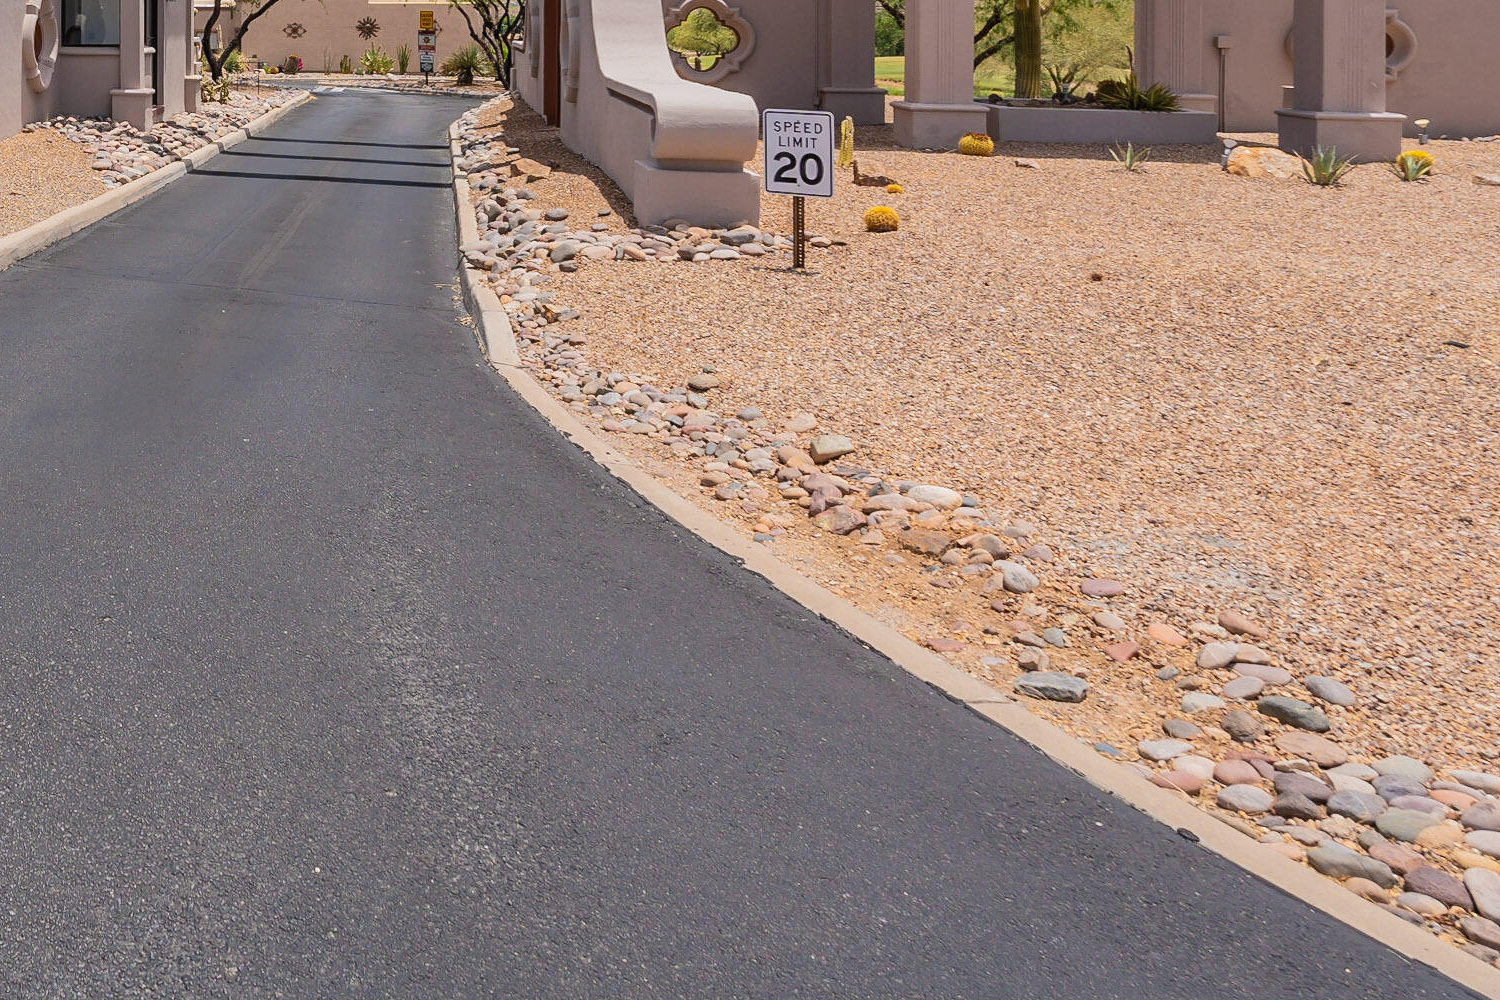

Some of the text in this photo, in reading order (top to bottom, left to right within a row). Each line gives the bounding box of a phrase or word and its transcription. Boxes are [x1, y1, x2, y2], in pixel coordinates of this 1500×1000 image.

[773, 121, 823, 135] SPEED
[778, 135, 818, 149] LIMIT
[773, 151, 824, 186] 20
